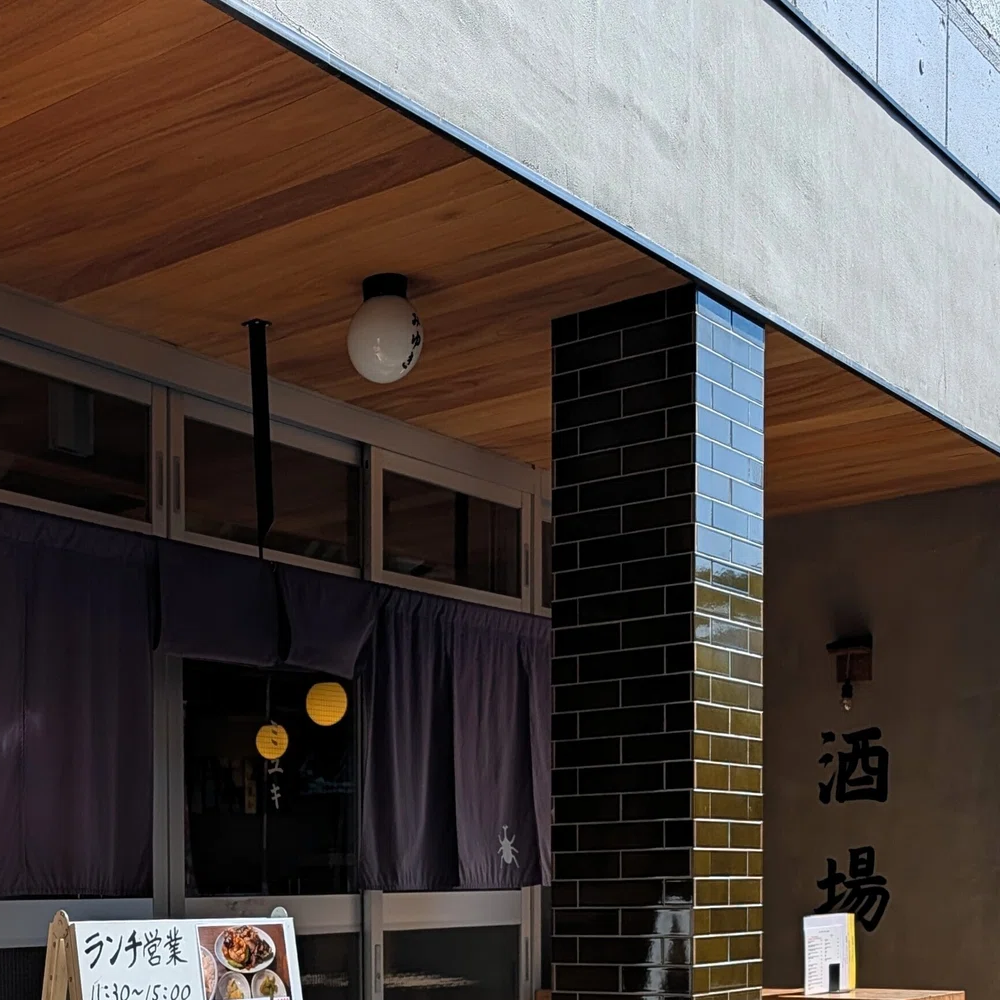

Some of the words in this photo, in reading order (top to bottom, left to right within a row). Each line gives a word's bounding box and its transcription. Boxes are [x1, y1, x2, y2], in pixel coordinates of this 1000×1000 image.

[401, 312, 422, 370] みゆき
[814, 726, 890, 933] 酒場
[84, 926, 188, 969] ランチ営業
